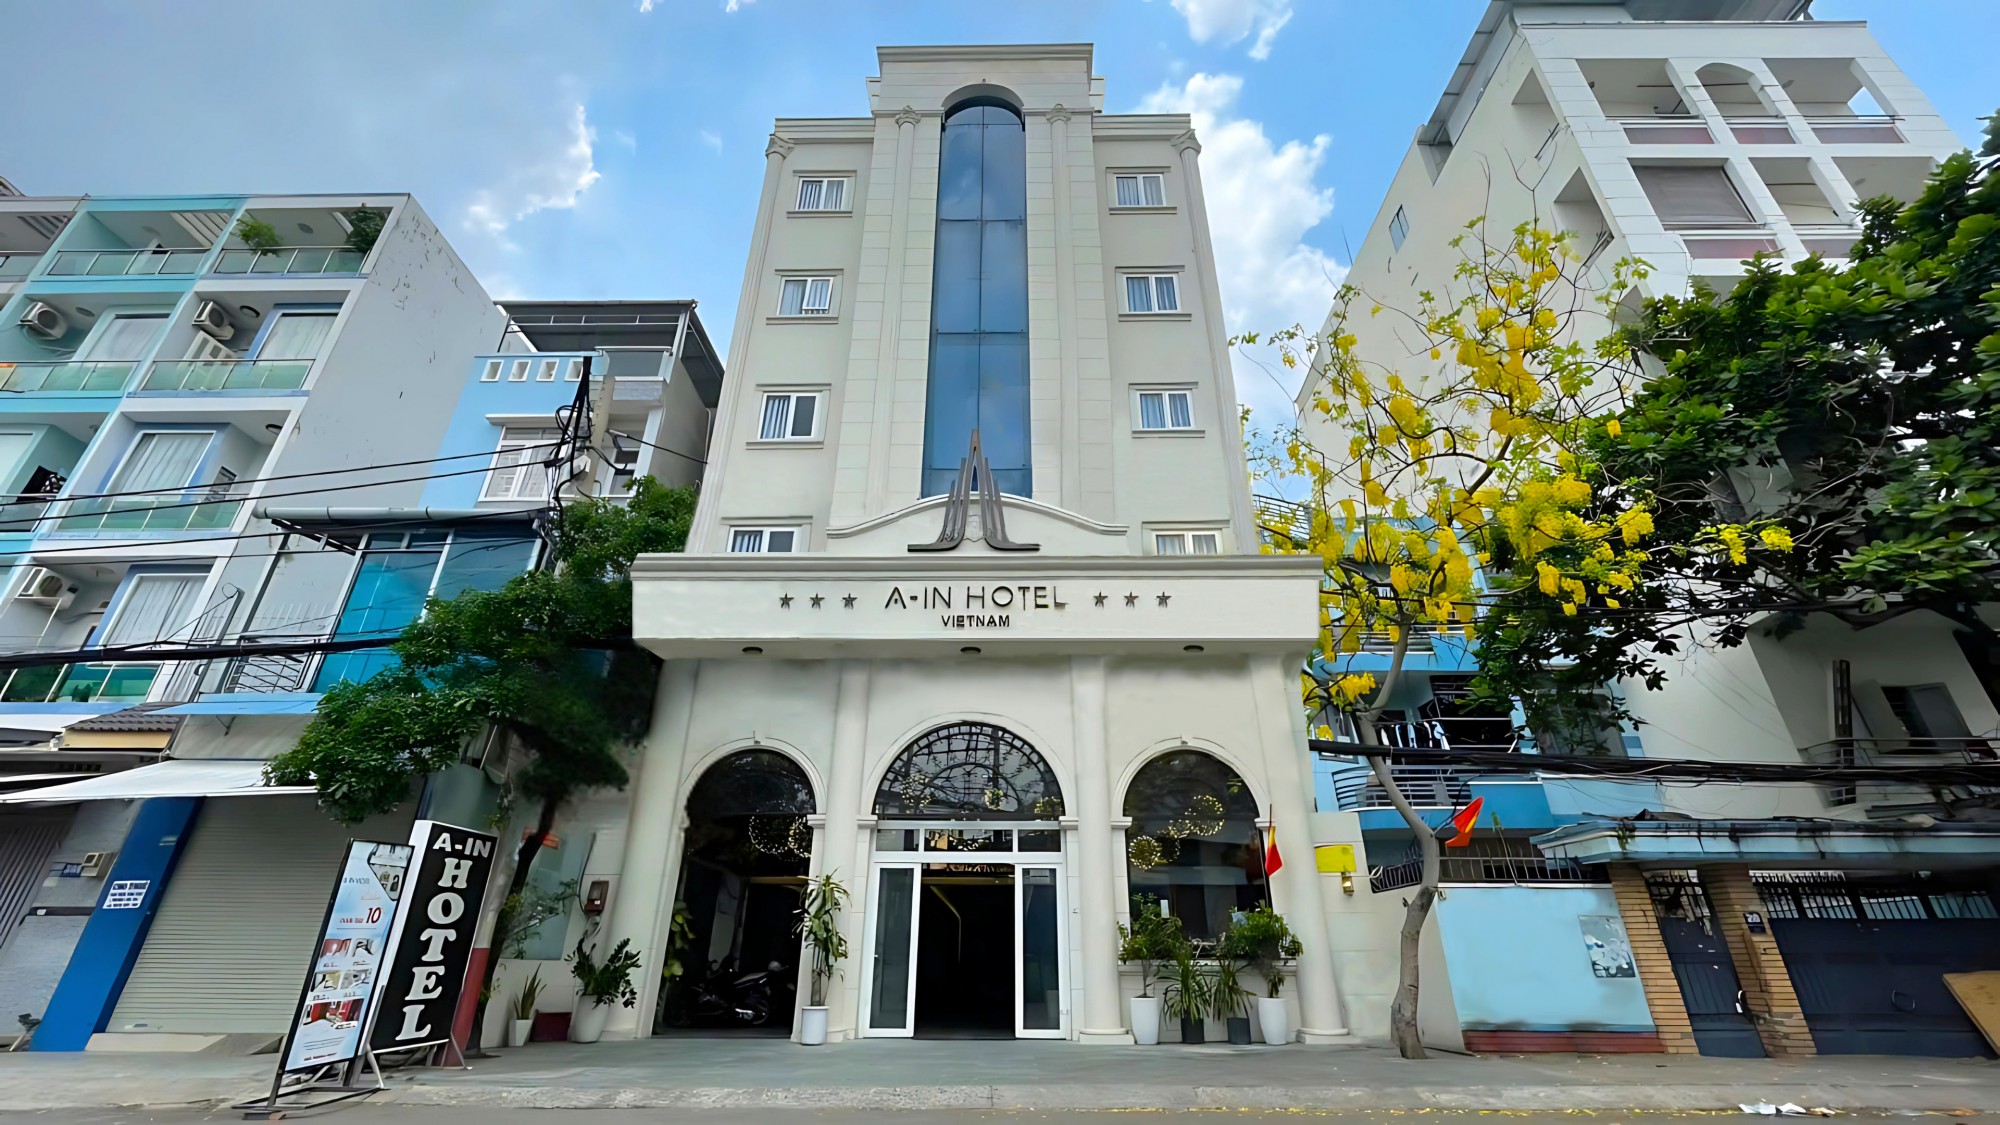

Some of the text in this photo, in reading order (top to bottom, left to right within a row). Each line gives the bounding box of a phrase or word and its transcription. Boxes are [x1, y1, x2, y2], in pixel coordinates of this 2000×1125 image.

[885, 585, 1068, 611] A-IN HOTEL
[941, 614, 1010, 628] VIETNAM
[432, 832, 492, 858] A-IN
[366, 906, 382, 924] 10
[395, 857, 473, 1040] HOTEL
